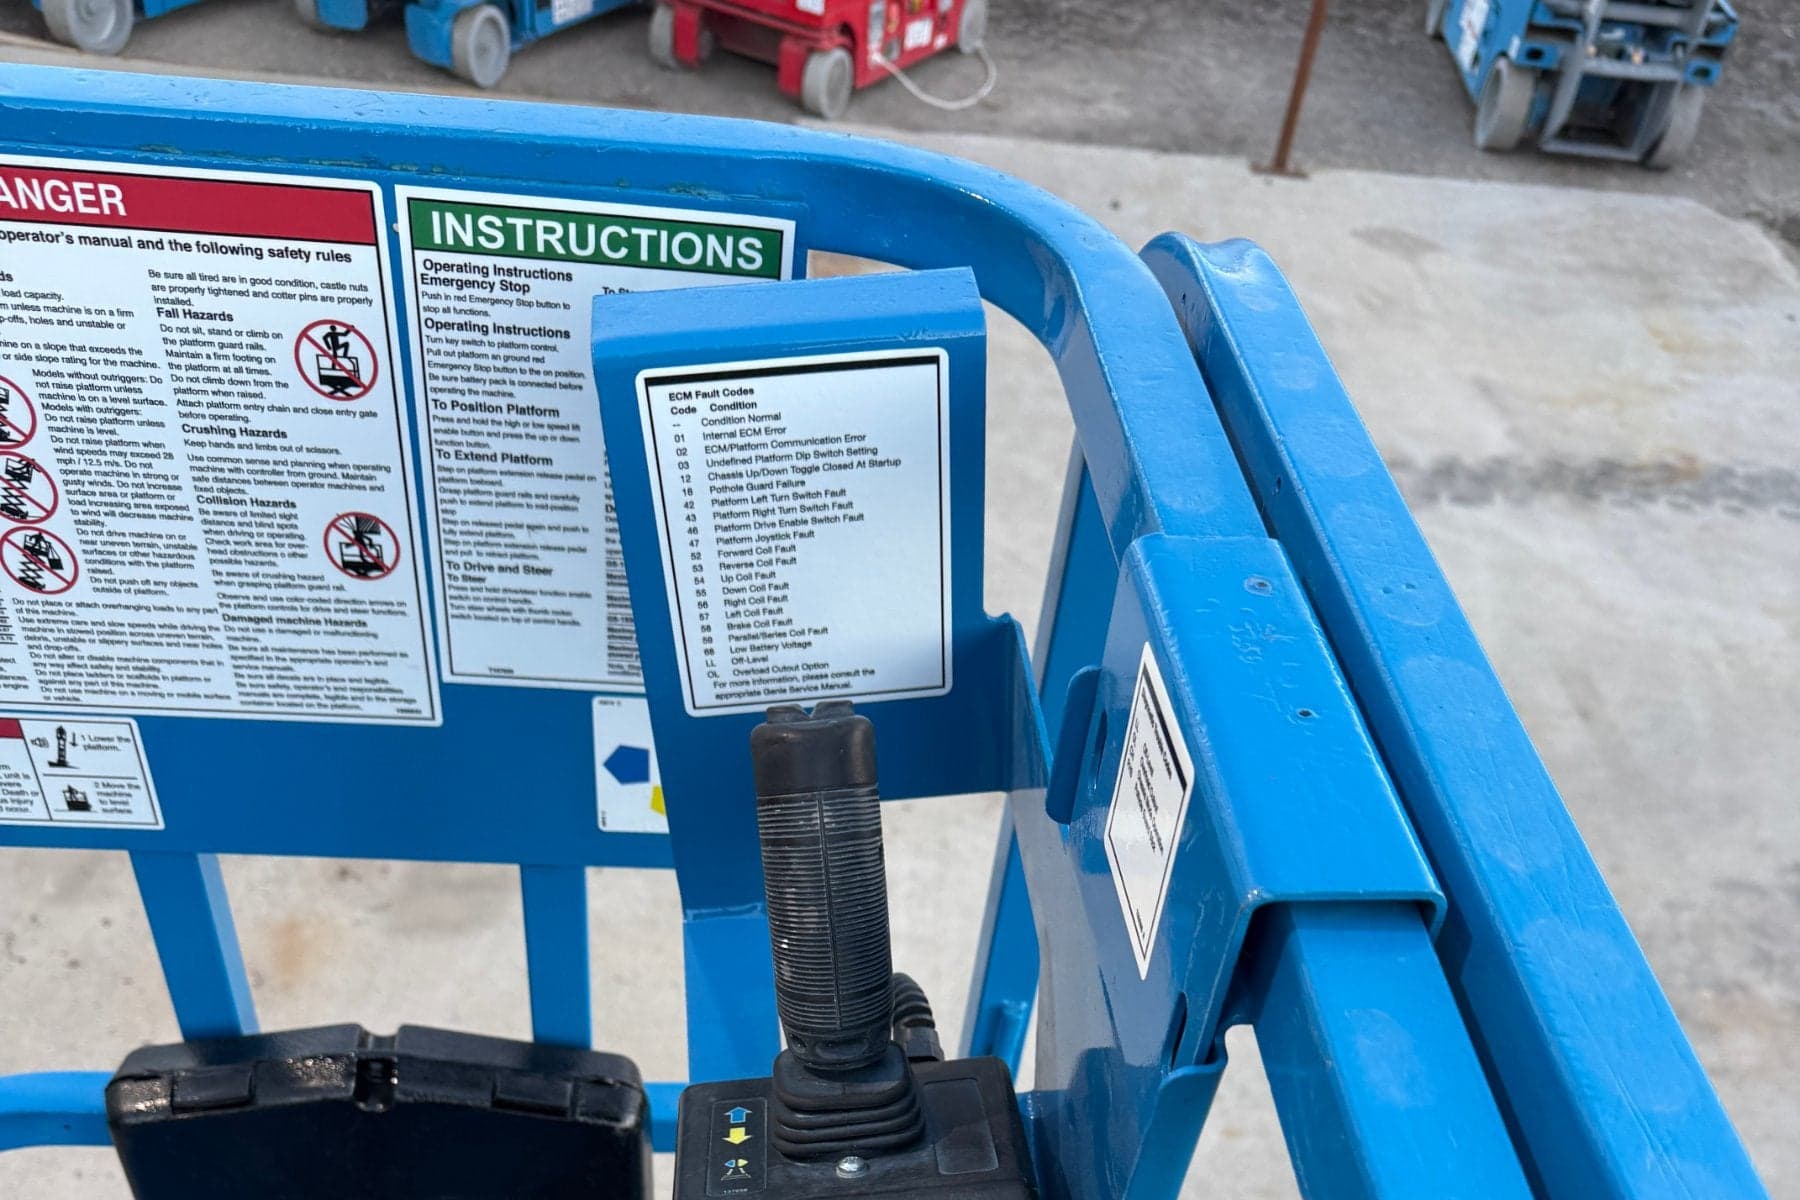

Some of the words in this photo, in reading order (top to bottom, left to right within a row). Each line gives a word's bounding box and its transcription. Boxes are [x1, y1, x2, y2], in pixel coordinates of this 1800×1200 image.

[0, 229, 75, 245] operator's
[78, 235, 133, 248] manual
[136, 238, 165, 250] and
[168, 239, 192, 252] the
[195, 240, 264, 260] following
[267, 246, 311, 263] safety
[315, 249, 352, 263] rules
[431, 210, 764, 271] INSTRUCTIONS
[423, 258, 489, 278] Operating
[493, 264, 573, 282] Instructions
[148, 269, 161, 278] Be
[163, 272, 184, 280] sure
[186, 272, 197, 281] all
[238, 275, 248, 284] in
[249, 277, 273, 287] good
[274, 278, 318, 290] condition,
[320, 281, 347, 291] castle
[349, 283, 369, 292] nuts
[420, 272, 496, 293] Emergency
[499, 279, 531, 295] Stop
[151, 284, 166, 292] are
[168, 285, 205, 296] properly
[207, 286, 250, 298] tightened
[252, 290, 270, 298] and
[271, 292, 296, 300] cotter
[298, 292, 318, 303] pins
[320, 295, 335, 303] are
[337, 296, 373, 307] properly
[421, 290, 442, 300] Push
[444, 293, 452, 301] in
[454, 294, 467, 302] red
[468, 294, 514, 308] Emergency
[516, 298, 534, 309] Stop
[536, 299, 561, 309] button
[562, 302, 571, 310] to
[10, 302, 41, 312] unless
[43, 305, 82, 315] machine
[84, 306, 93, 315] is
[94, 308, 106, 316] on
[108, 309, 115, 317] a
[116, 308, 135, 318] firm
[156, 306, 180, 319] Fall
[182, 308, 234, 322] Hazards
[422, 305, 440, 315] stop
[442, 306, 451, 314] all
[453, 306, 491, 317] functions.
[159, 323, 173, 333] Do
[175, 326, 190, 334] not
[192, 326, 205, 336] sit,
[207, 328, 233, 337] stand
[246, 329, 270, 339] climb
[271, 332, 283, 340] on
[424, 317, 489, 336] Operating
[493, 322, 571, 340] Instructions
[425, 334, 444, 344] Turn
[444, 336, 460, 347] key
[461, 338, 486, 347] switch
[487, 340, 496, 348] to
[497, 340, 530, 350] platform
[530, 344, 559, 353] control.
[668, 391, 693, 402] ECM
[695, 389, 720, 399] Fault
[722, 387, 755, 397] Codes
[431, 398, 447, 410] To
[450, 400, 503, 414] Position
[506, 403, 560, 418] Platform
[670, 405, 697, 415] Code
[709, 401, 757, 412] Condition
[701, 416, 746, 427] Condition
[748, 411, 782, 423] Normal
[181, 423, 237, 438] Crushing
[239, 426, 288, 439] Hazards
[674, 433, 685, 443] 01
[702, 429, 737, 441] Internal
[739, 427, 762, 438] ECM
[764, 426, 787, 436] Error
[675, 447, 688, 457] 02
[704, 442, 769, 454] ECM/Platform
[770, 436, 842, 449] Communication
[844, 434, 867, 443] Error
[435, 448, 451, 460] To
[454, 449, 498, 463] Extend
[501, 452, 553, 466] Platform
[677, 460, 690, 470] 03
[706, 456, 753, 468] Undefined
[754, 453, 793, 464] Platform
[795, 451, 811, 462] Dip
[813, 448, 844, 459] Switch
[846, 447, 878, 457] Setting
[680, 474, 691, 484] 12
[707, 470, 744, 481] Chassis
[745, 468, 788, 479] Up/Down
[790, 464, 820, 476] Toggle
[822, 460, 854, 472] Closed
[856, 460, 866, 469] At
[868, 458, 902, 468] Startup
[709, 484, 744, 494] Pothole
[746, 480, 774, 492] Guard
[776, 479, 806, 489] Failure
[196, 494, 248, 506] Collision
[249, 497, 297, 509] Hazards
[683, 500, 695, 510] 42
[711, 497, 749, 507] Platform
[750, 494, 768, 504] Left
[770, 493, 790, 502] Turn
[792, 490, 822, 501] Switch
[824, 488, 846, 498] Fault
[685, 513, 697, 522] 43
[712, 510, 750, 520] Platform
[752, 507, 776, 518] Right
[777, 506, 797, 515] Turn
[799, 503, 830, 514] Switch
[831, 501, 854, 511] Fault
[714, 523, 752, 533] Platform
[753, 521, 777, 530] Drive
[778, 517, 809, 528] Enable
[810, 515, 841, 525] Switch
[842, 513, 864, 522] Fault
[689, 539, 700, 548] 47
[716, 536, 753, 545] Platform
[755, 531, 791, 544] Joystick
[793, 529, 815, 540] Fault
[690, 551, 702, 561] 52
[717, 547, 754, 558] Forward
[755, 546, 773, 555] Coil
[774, 544, 796, 554] Fault
[445, 560, 460, 571] To
[463, 561, 495, 572] Drive
[498, 564, 520, 574] and
[523, 564, 553, 576] Steer
[692, 564, 704, 573] 53
[719, 561, 754, 571] Reverse
[756, 558, 773, 568] Coil
[775, 556, 797, 566] Fault
[222, 613, 273, 625] Damaged
[275, 617, 322, 627] machine
[324, 618, 369, 628] Hazards
